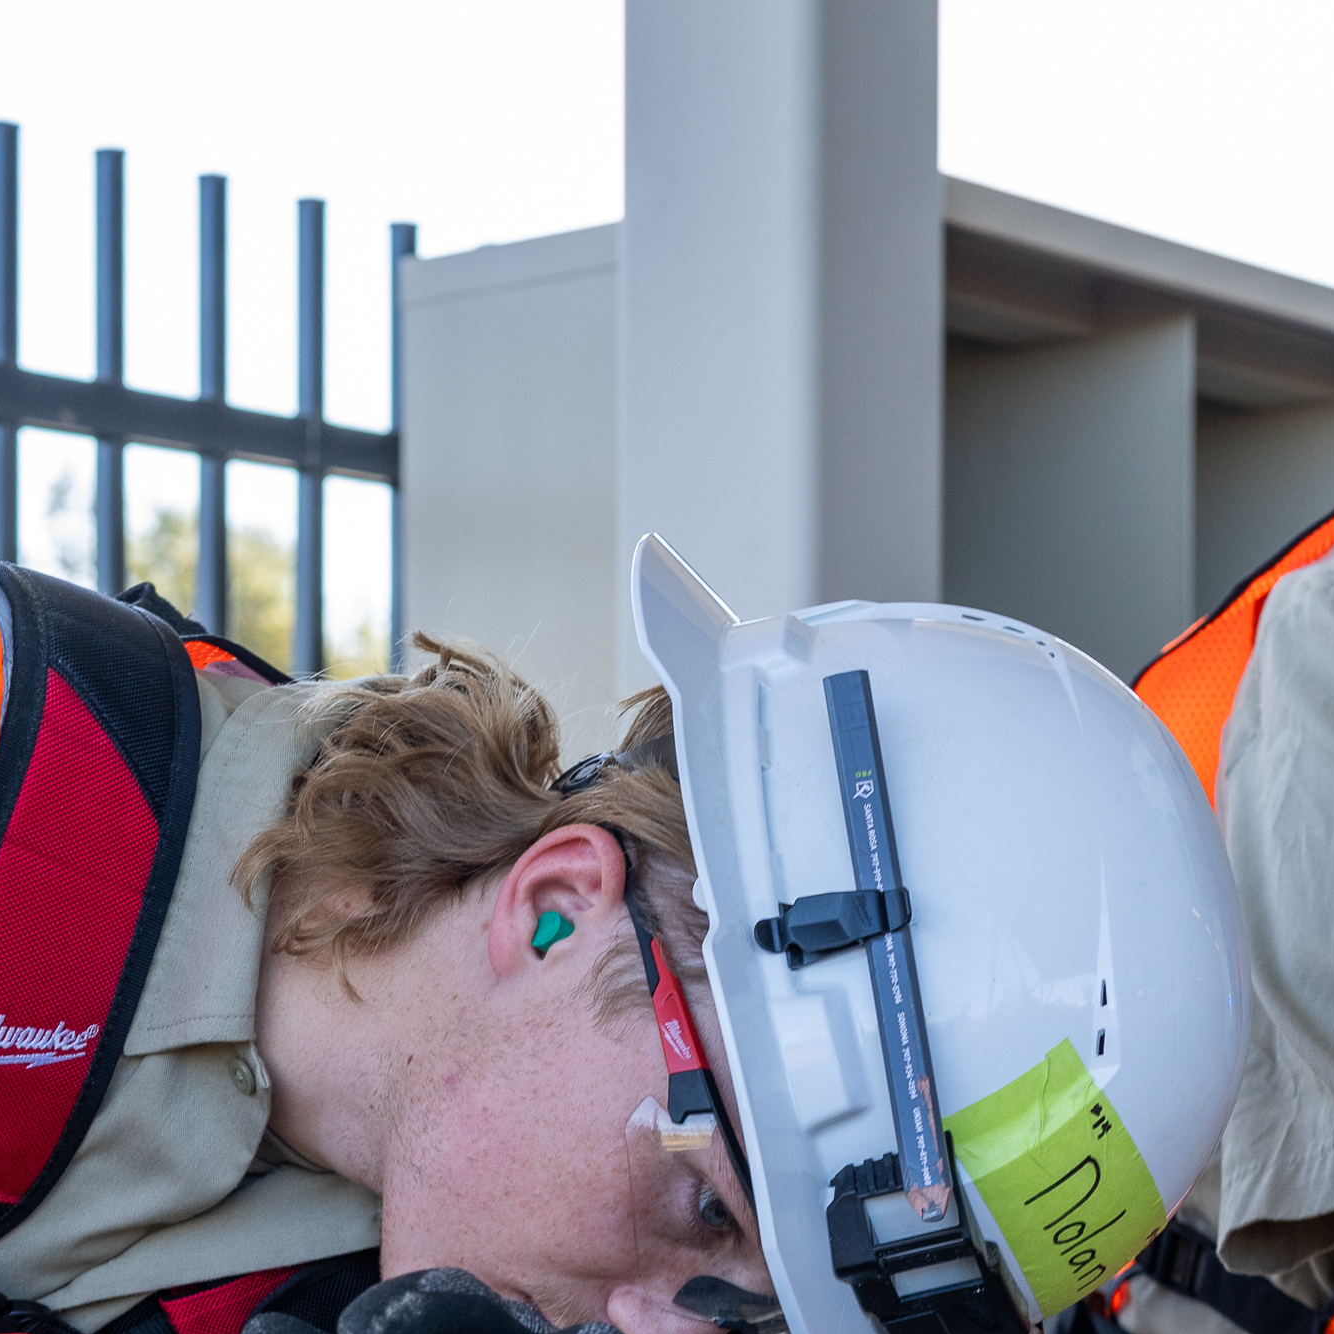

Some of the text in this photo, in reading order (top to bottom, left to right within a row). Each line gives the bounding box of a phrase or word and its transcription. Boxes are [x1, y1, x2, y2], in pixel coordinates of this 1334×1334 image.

[864, 803, 874, 830] SANTA
[868, 829, 878, 851] ROSA
[897, 1011, 910, 1047] SONOMA
[1023, 1154, 1127, 1293] Nolan
